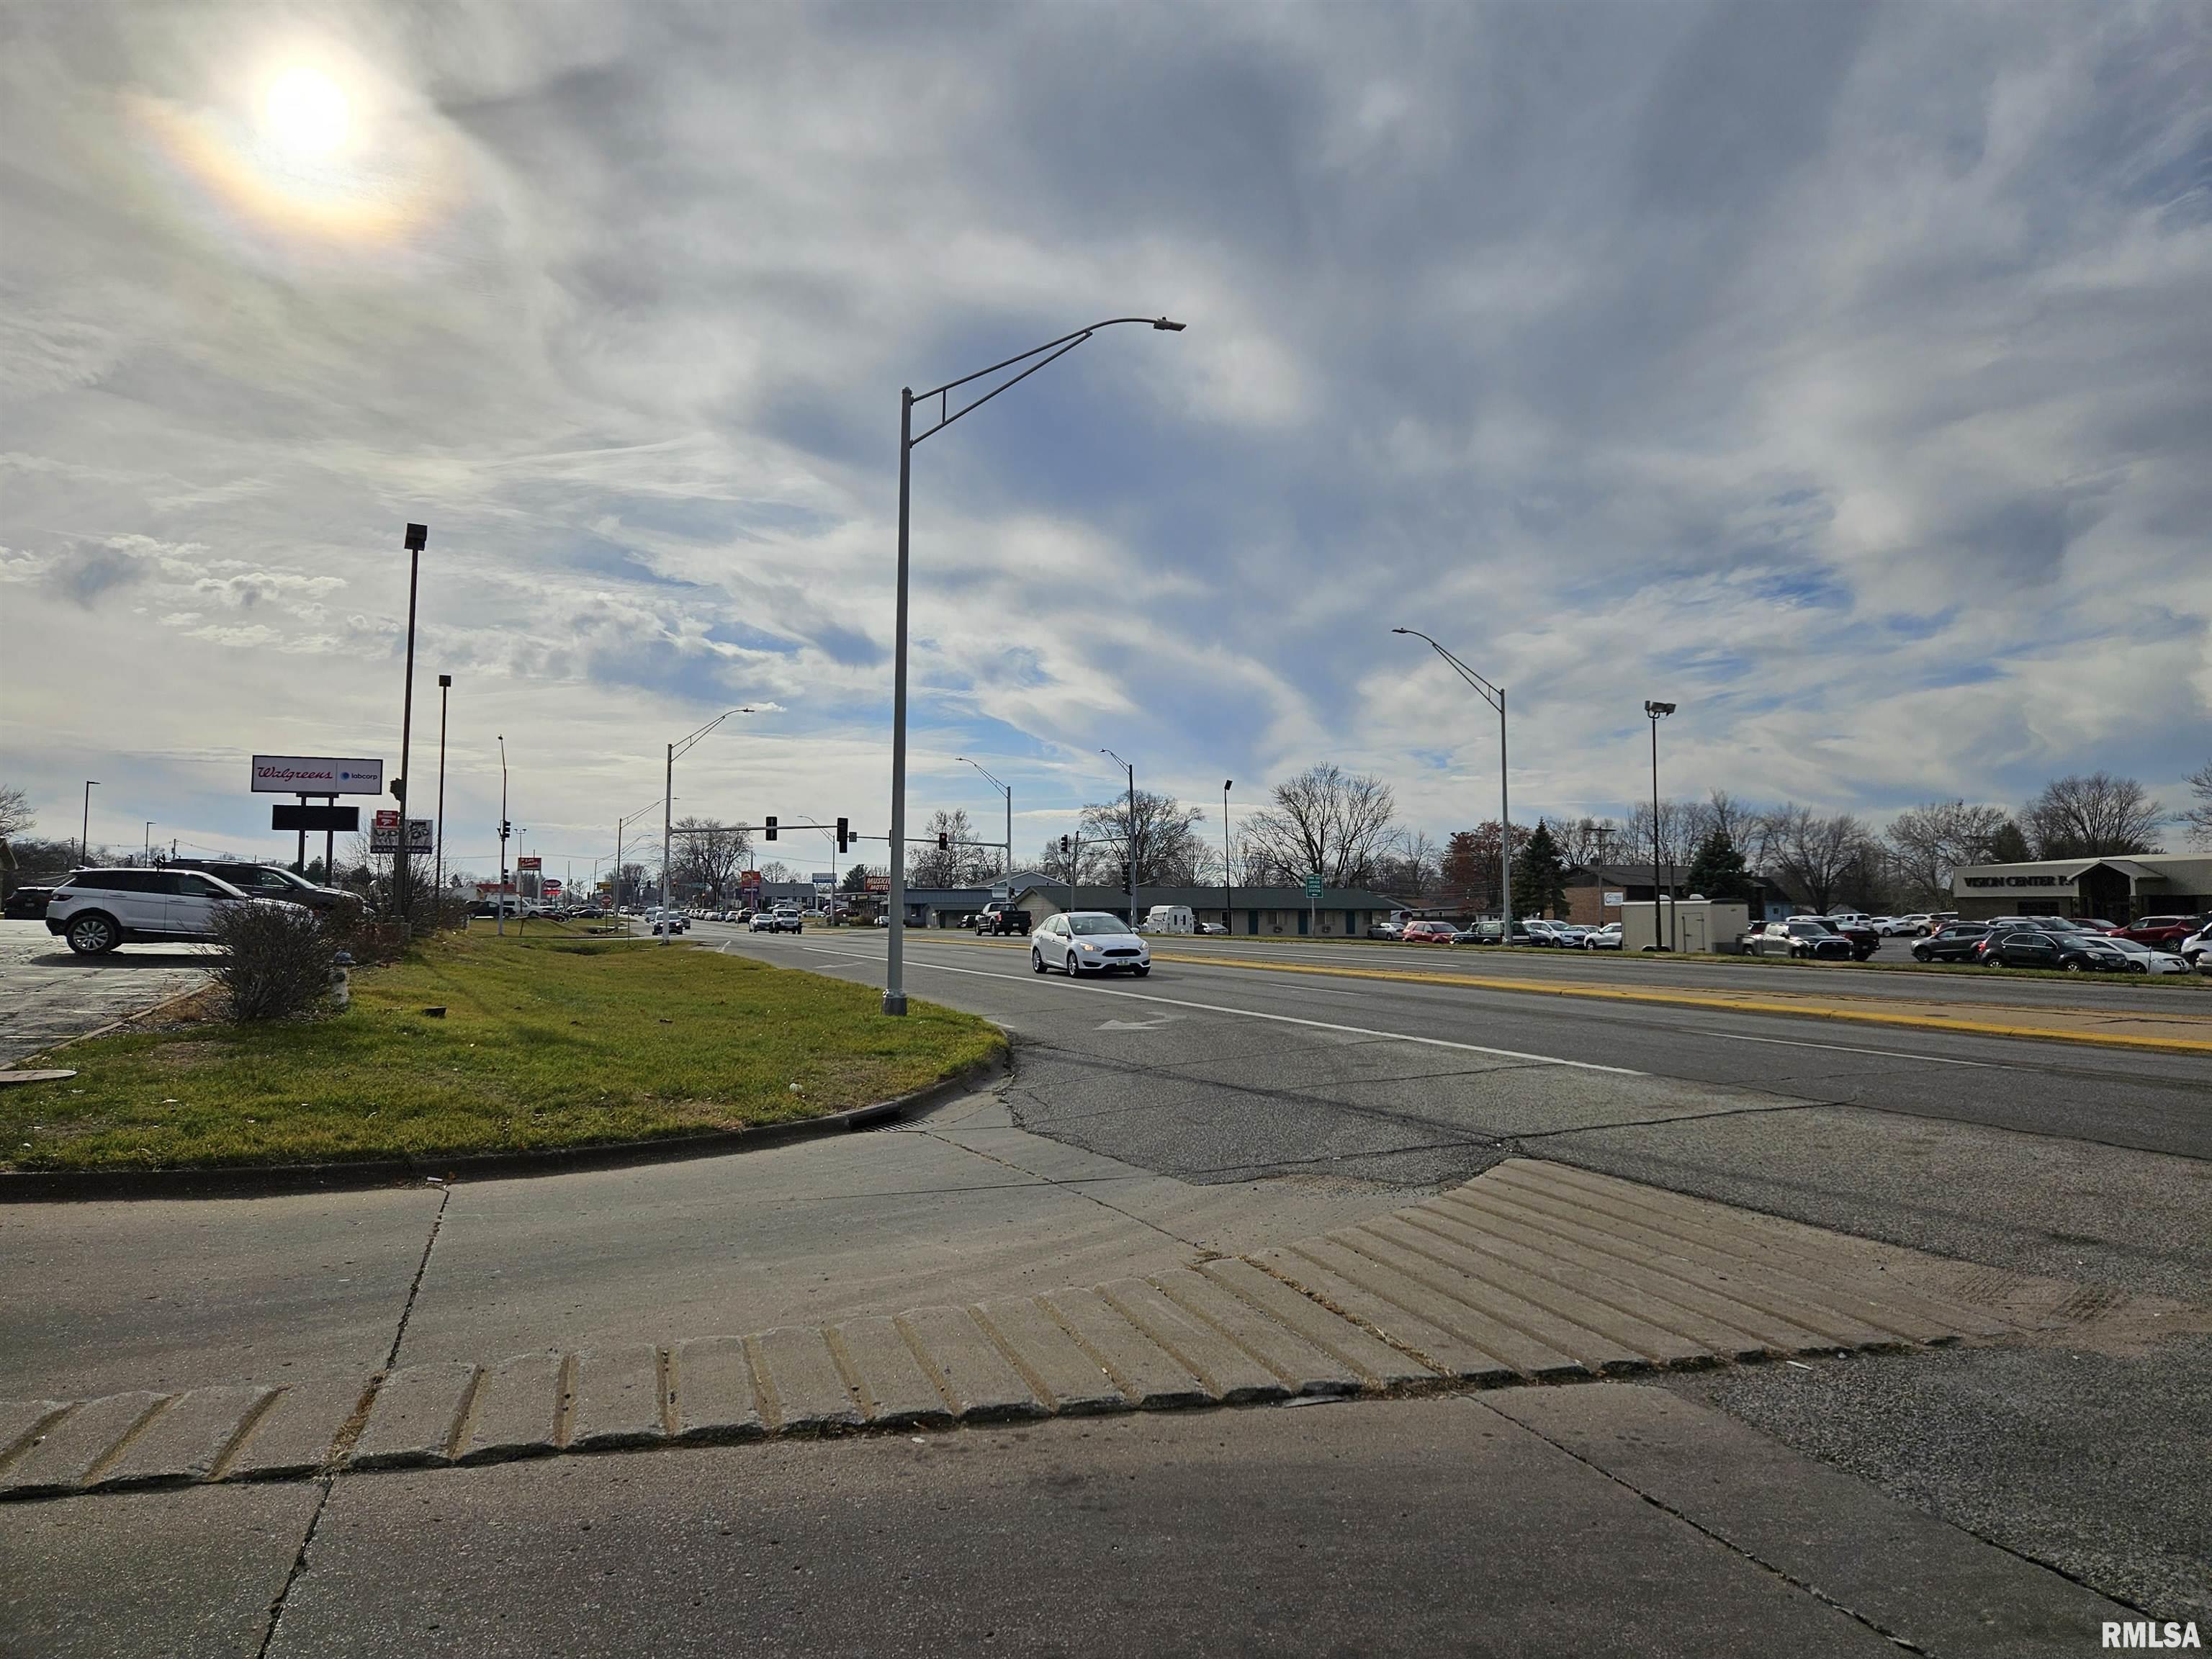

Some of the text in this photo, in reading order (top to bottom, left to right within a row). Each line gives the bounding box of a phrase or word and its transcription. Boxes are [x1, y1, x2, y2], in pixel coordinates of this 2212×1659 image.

[257, 766, 333, 782] Walgreens
[1964, 877, 2005, 887] VISION
[2005, 876, 2056, 886] CENTER
